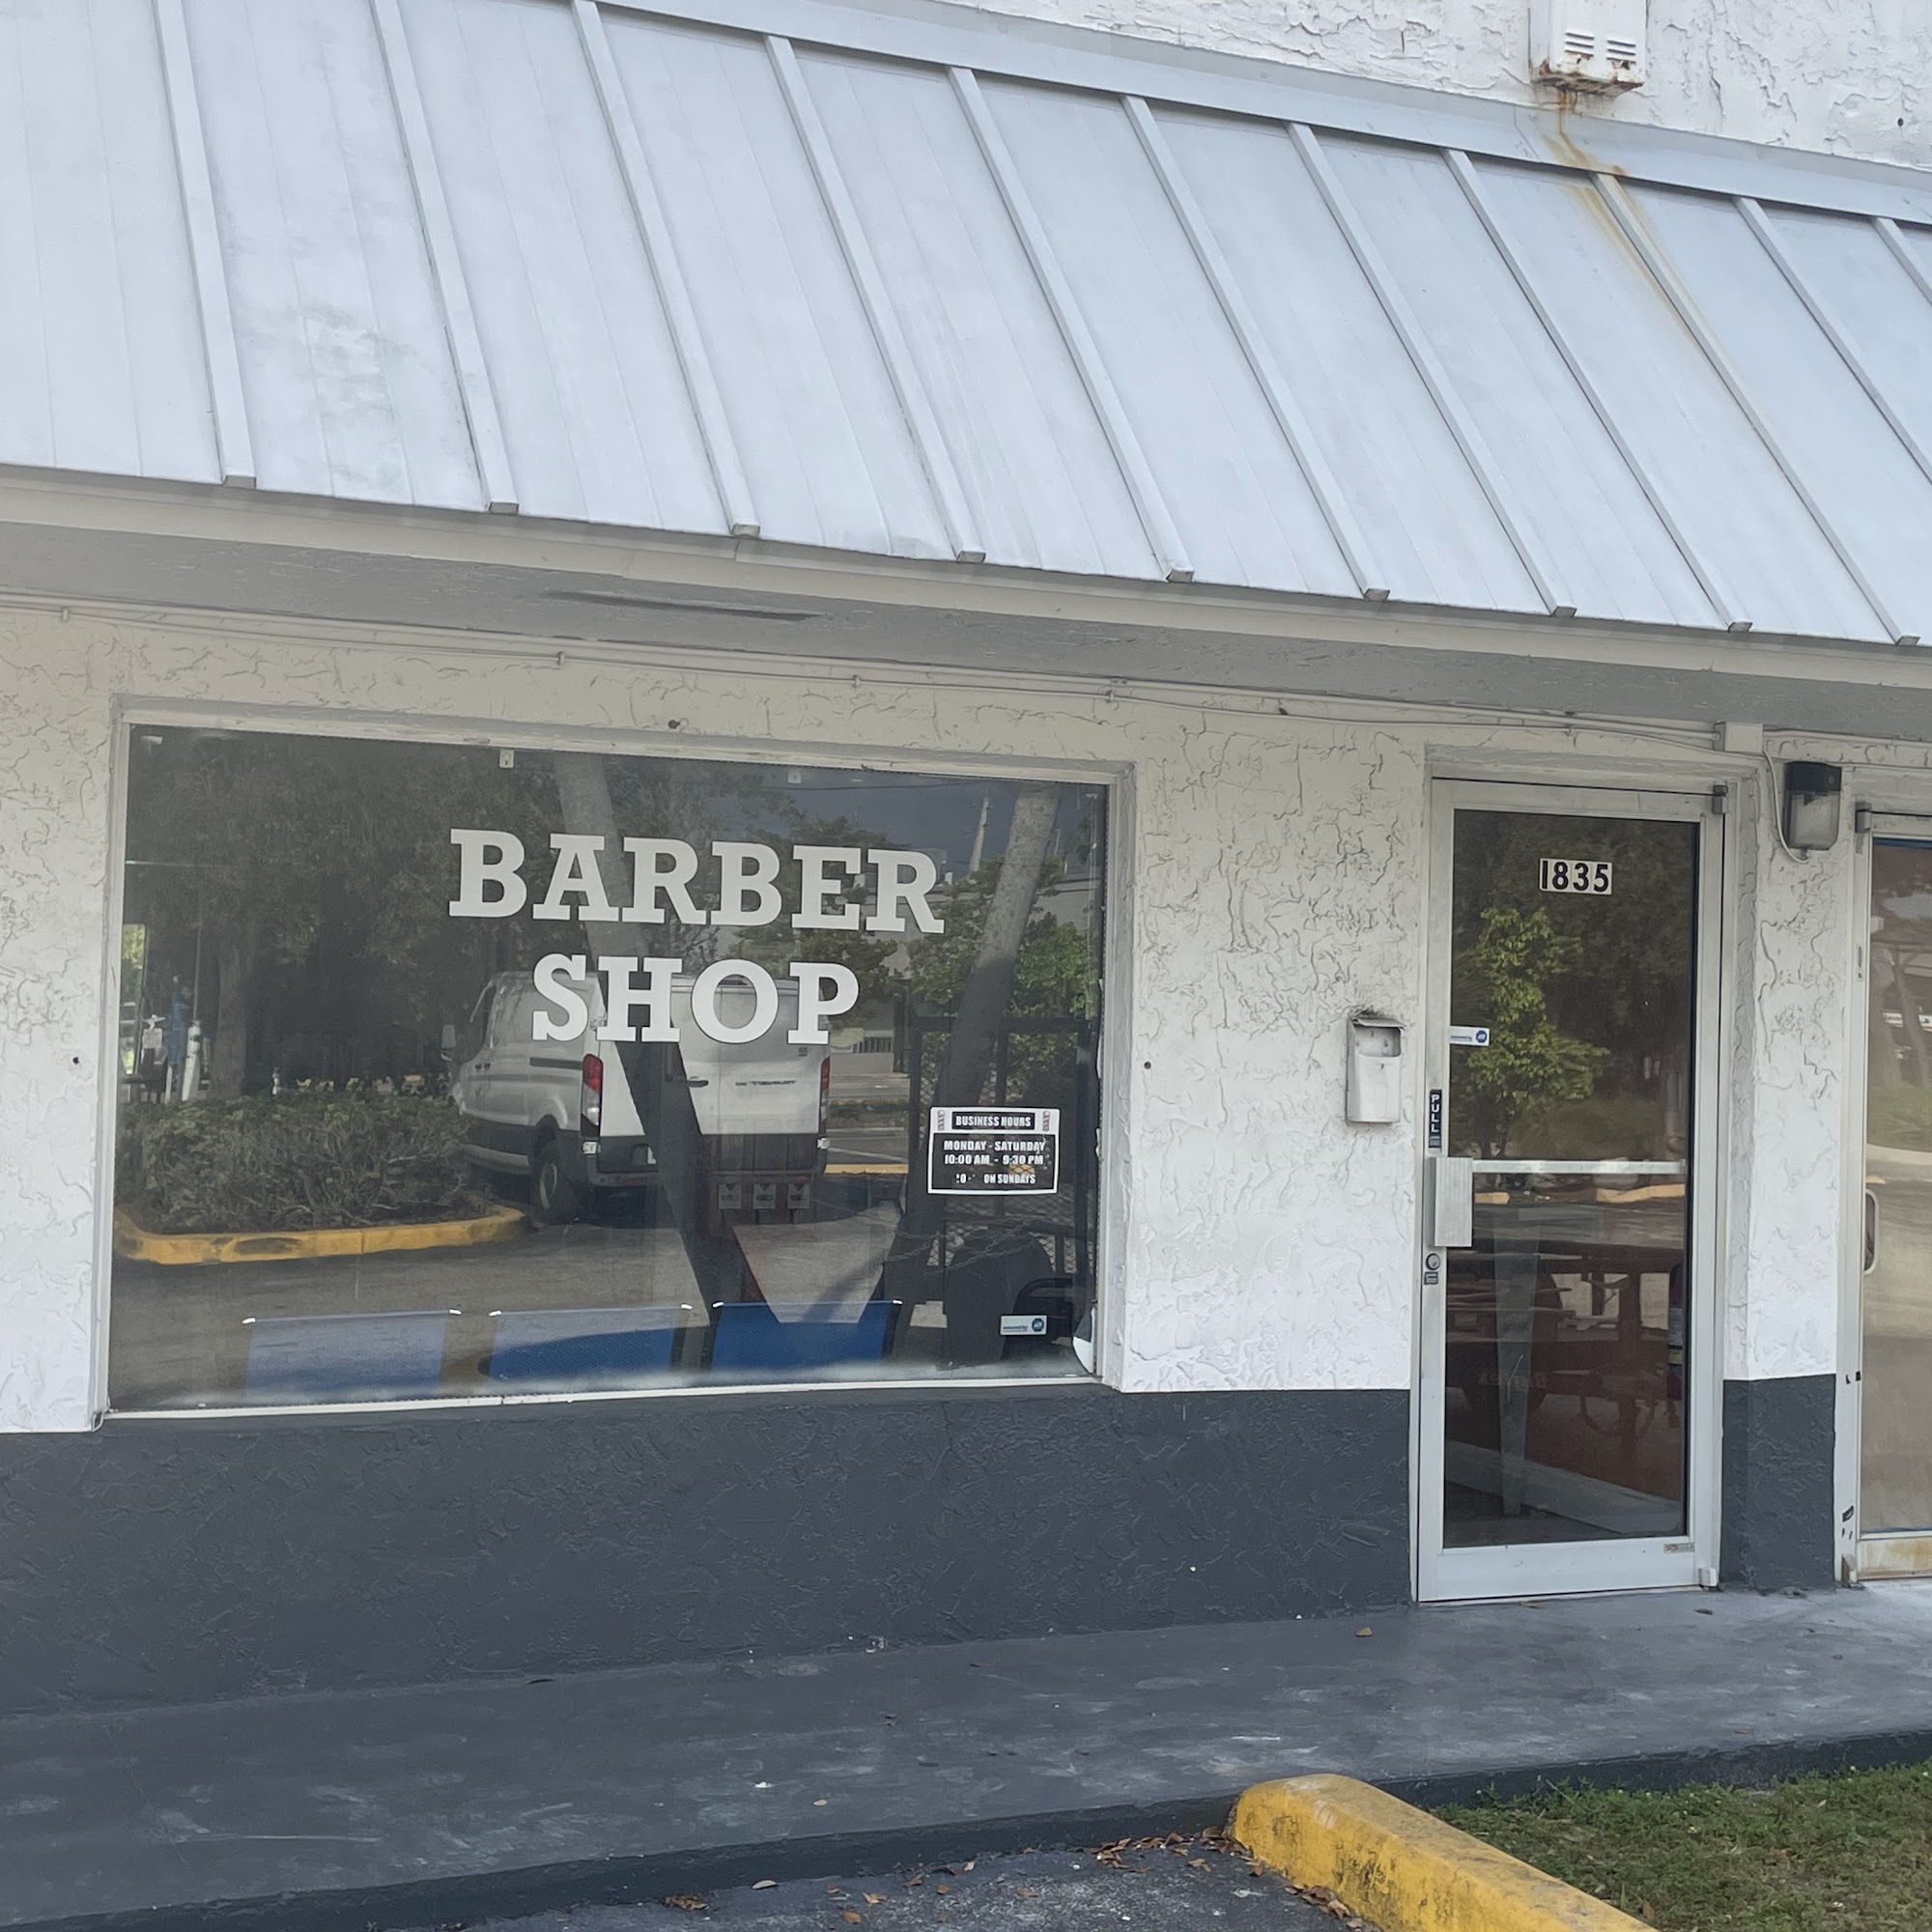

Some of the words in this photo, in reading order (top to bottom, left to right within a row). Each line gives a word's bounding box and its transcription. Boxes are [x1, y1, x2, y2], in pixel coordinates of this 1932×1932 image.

[449, 828, 945, 934] BARBER
[1542, 860, 1609, 893] 1835
[532, 952, 859, 1045] SHOP
[955, 1115, 1000, 1127] BUSINESS
[1001, 1116, 1032, 1127] HOURS
[1430, 1094, 1440, 1133] PULL
[943, 1140, 987, 1151] MONDAY
[994, 1141, 1045, 1152] SATURDAY
[944, 1153, 973, 1165] 10:00
[973, 1154, 990, 1165] AM
[1002, 1154, 1026, 1165] 9:30
[1027, 1155, 1044, 1165] PM
[983, 1174, 996, 1184] ON
[997, 1174, 1037, 1184] SUNDAYS
